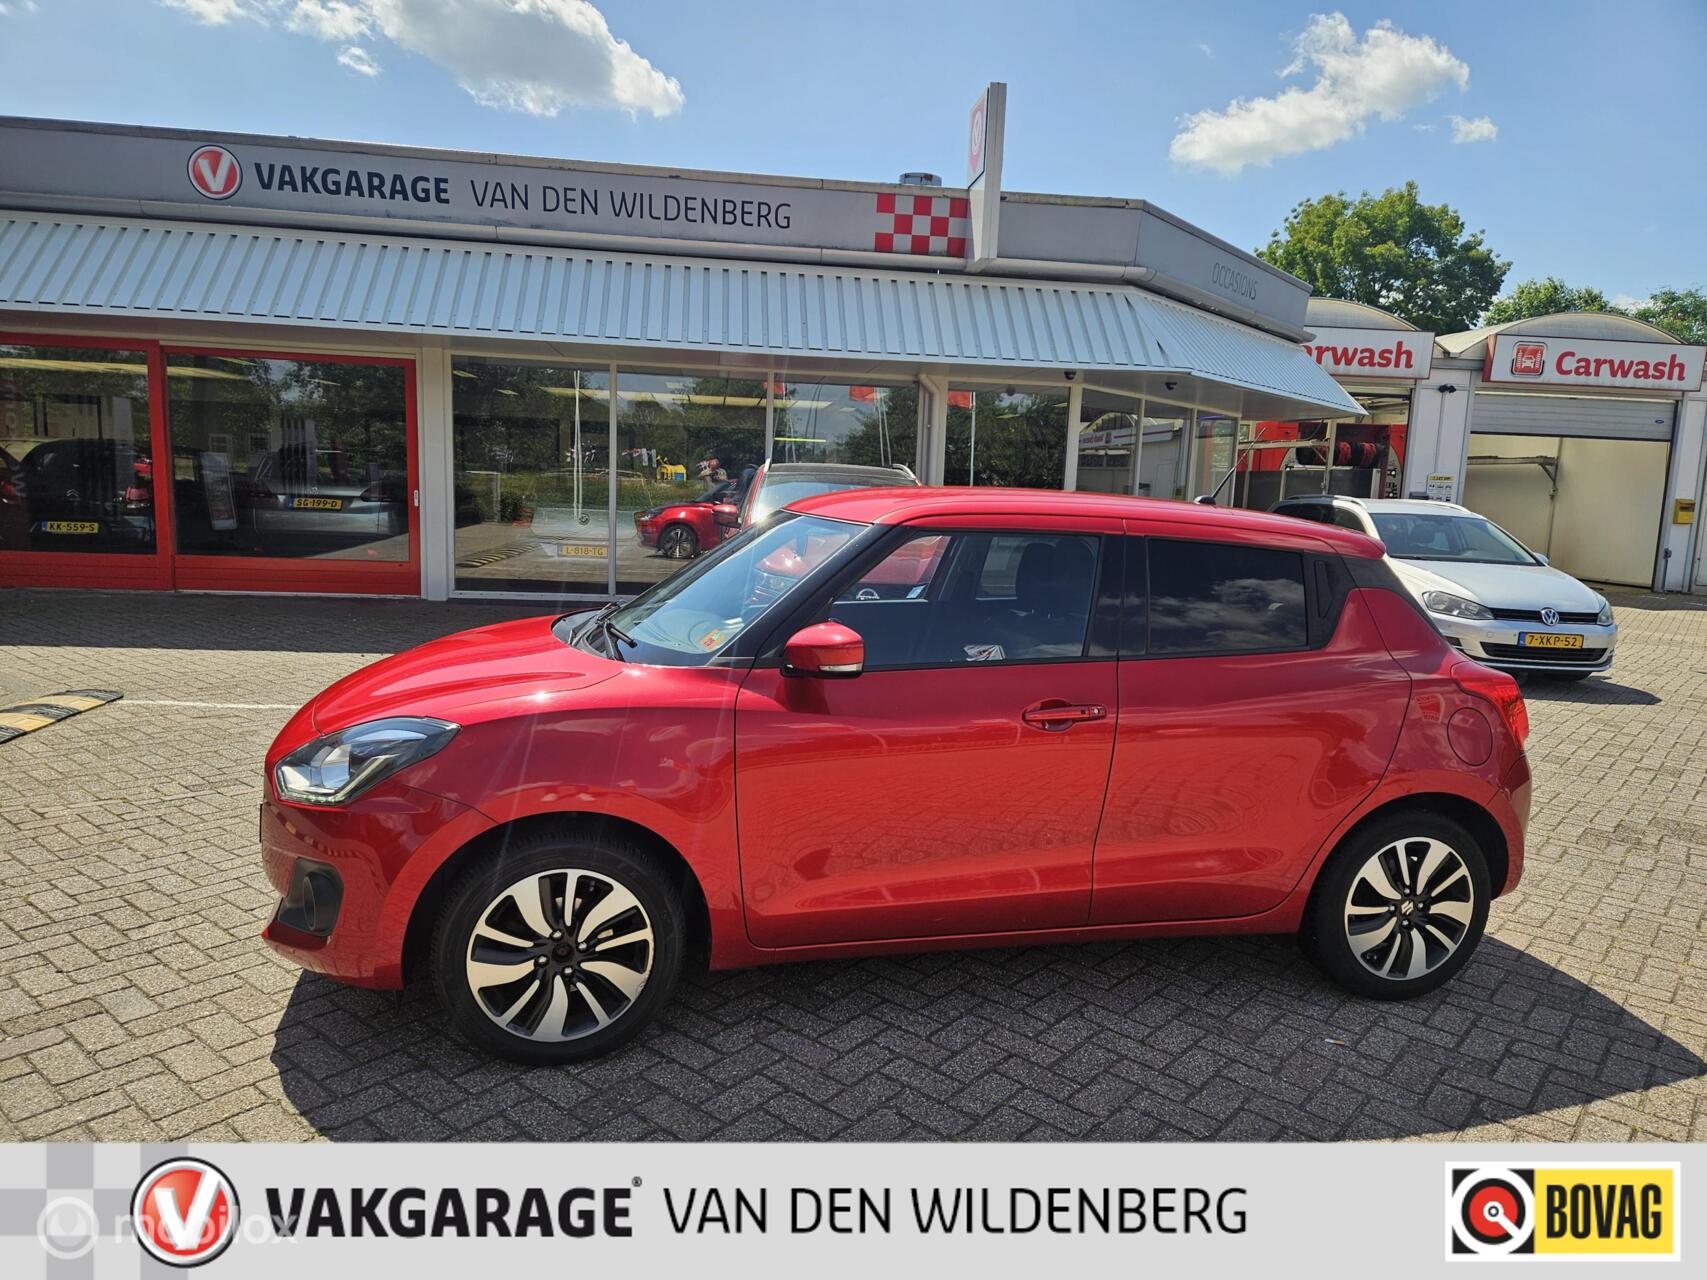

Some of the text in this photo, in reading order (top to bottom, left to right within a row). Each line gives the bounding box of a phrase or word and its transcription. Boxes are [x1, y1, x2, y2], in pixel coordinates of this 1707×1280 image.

[254, 162, 791, 230] VAKGARAGE VAN DEN WILDENBERG
[1212, 262, 1258, 300] OCCASIONS
[1555, 351, 1686, 382] Carwash
[296, 498, 338, 509] SG-199-D
[49, 521, 96, 533] KK-559-S
[1528, 635, 1577, 647] 7-XKP-52
